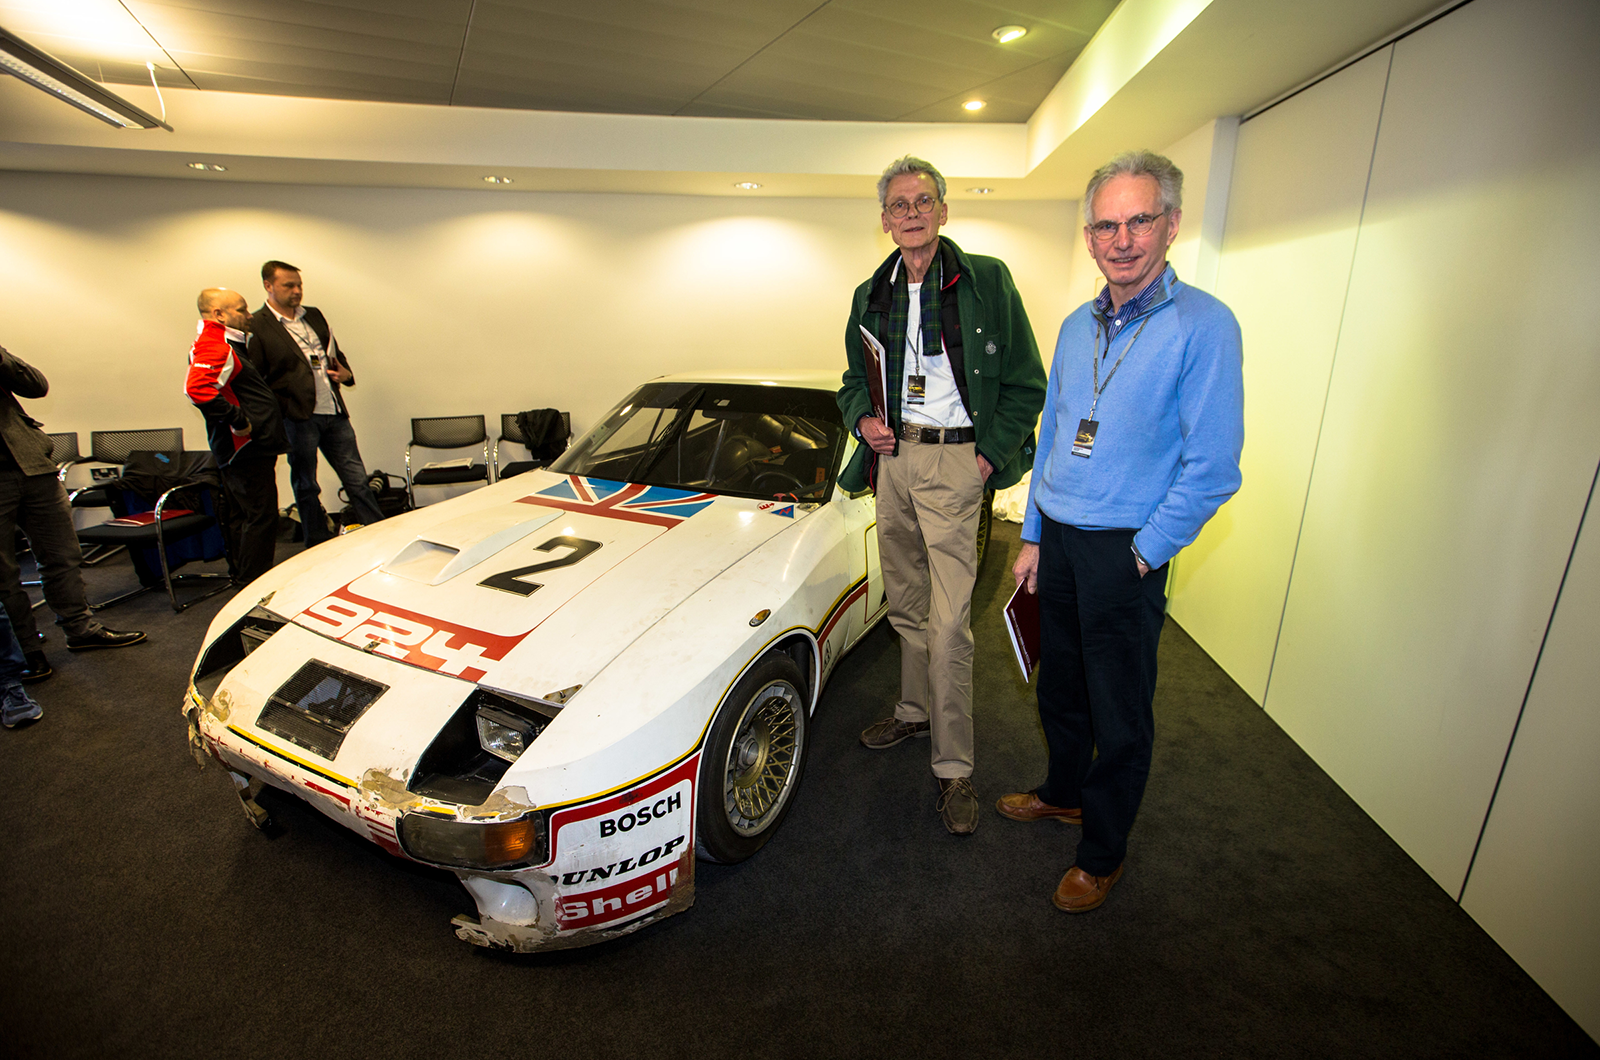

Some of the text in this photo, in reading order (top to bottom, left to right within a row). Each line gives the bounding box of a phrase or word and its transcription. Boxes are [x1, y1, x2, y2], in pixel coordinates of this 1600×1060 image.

[476, 535, 604, 598] 2
[291, 595, 497, 678] 924
[600, 790, 682, 838] BOSCH
